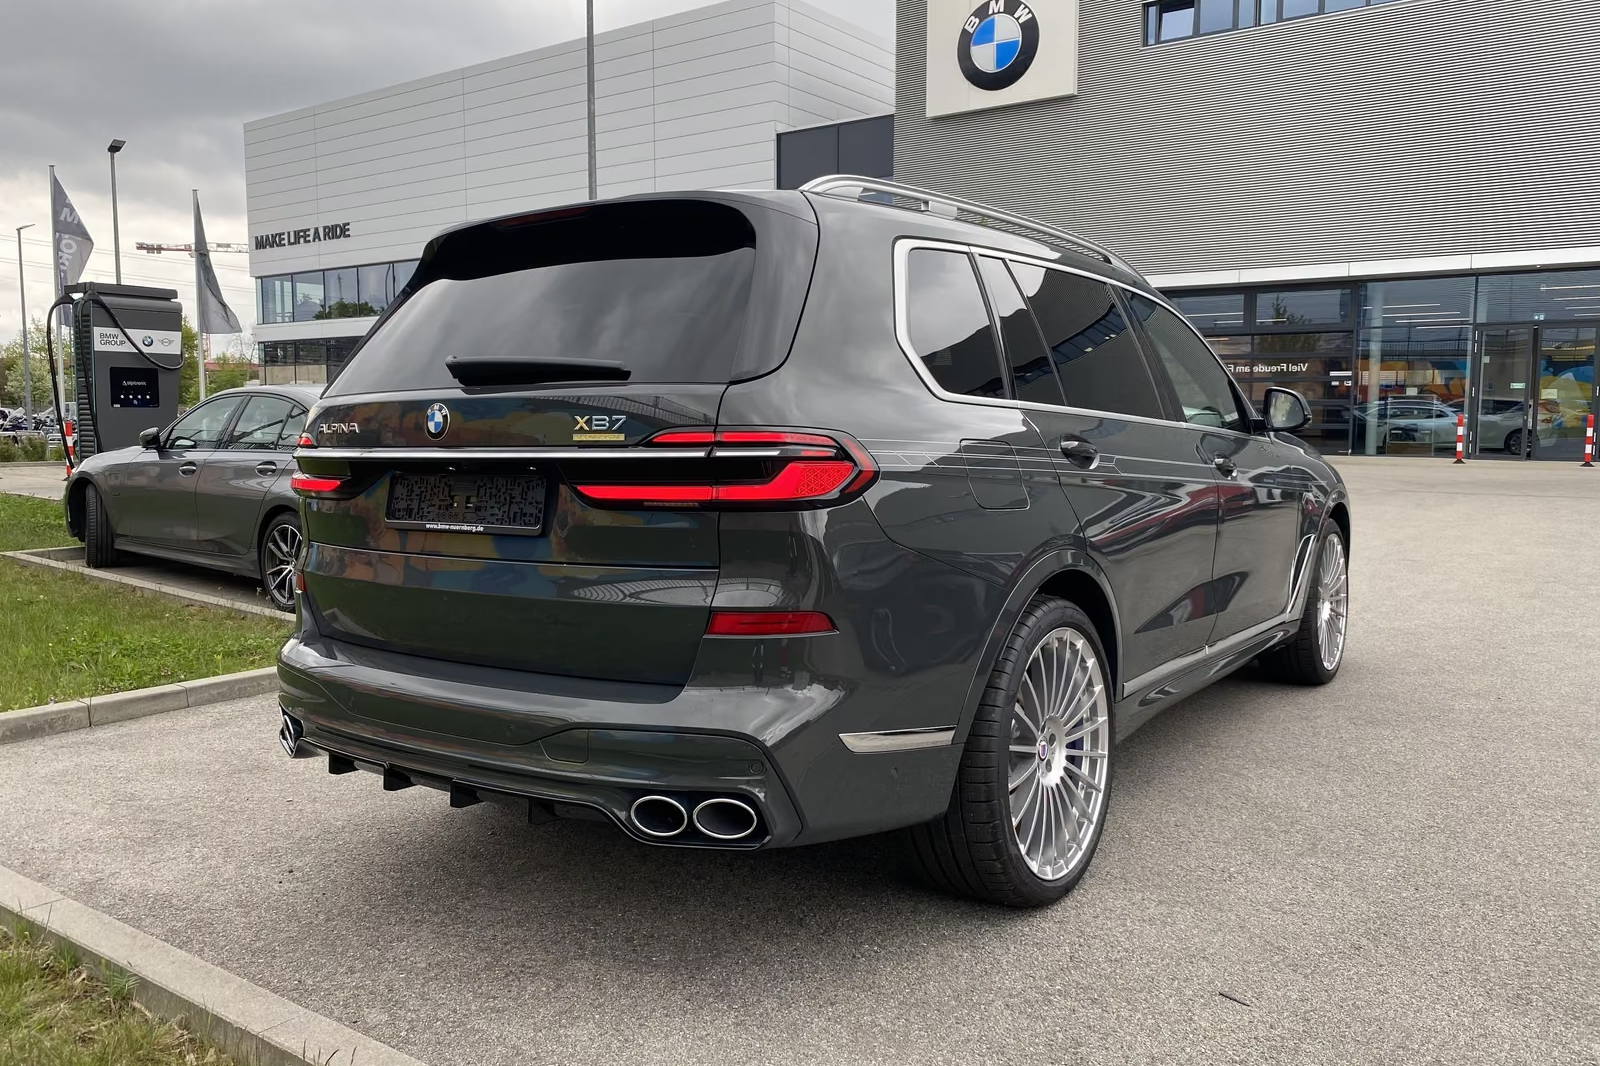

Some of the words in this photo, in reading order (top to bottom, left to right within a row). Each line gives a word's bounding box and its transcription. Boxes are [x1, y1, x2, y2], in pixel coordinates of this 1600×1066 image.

[964, 0, 1033, 34] BMW
[254, 232, 286, 250] MAKE
[286, 228, 311, 246] LIFE
[312, 227, 321, 242] A
[322, 222, 351, 241] RIDE
[318, 422, 360, 434] ALPINA
[573, 415, 627, 431] XB7
